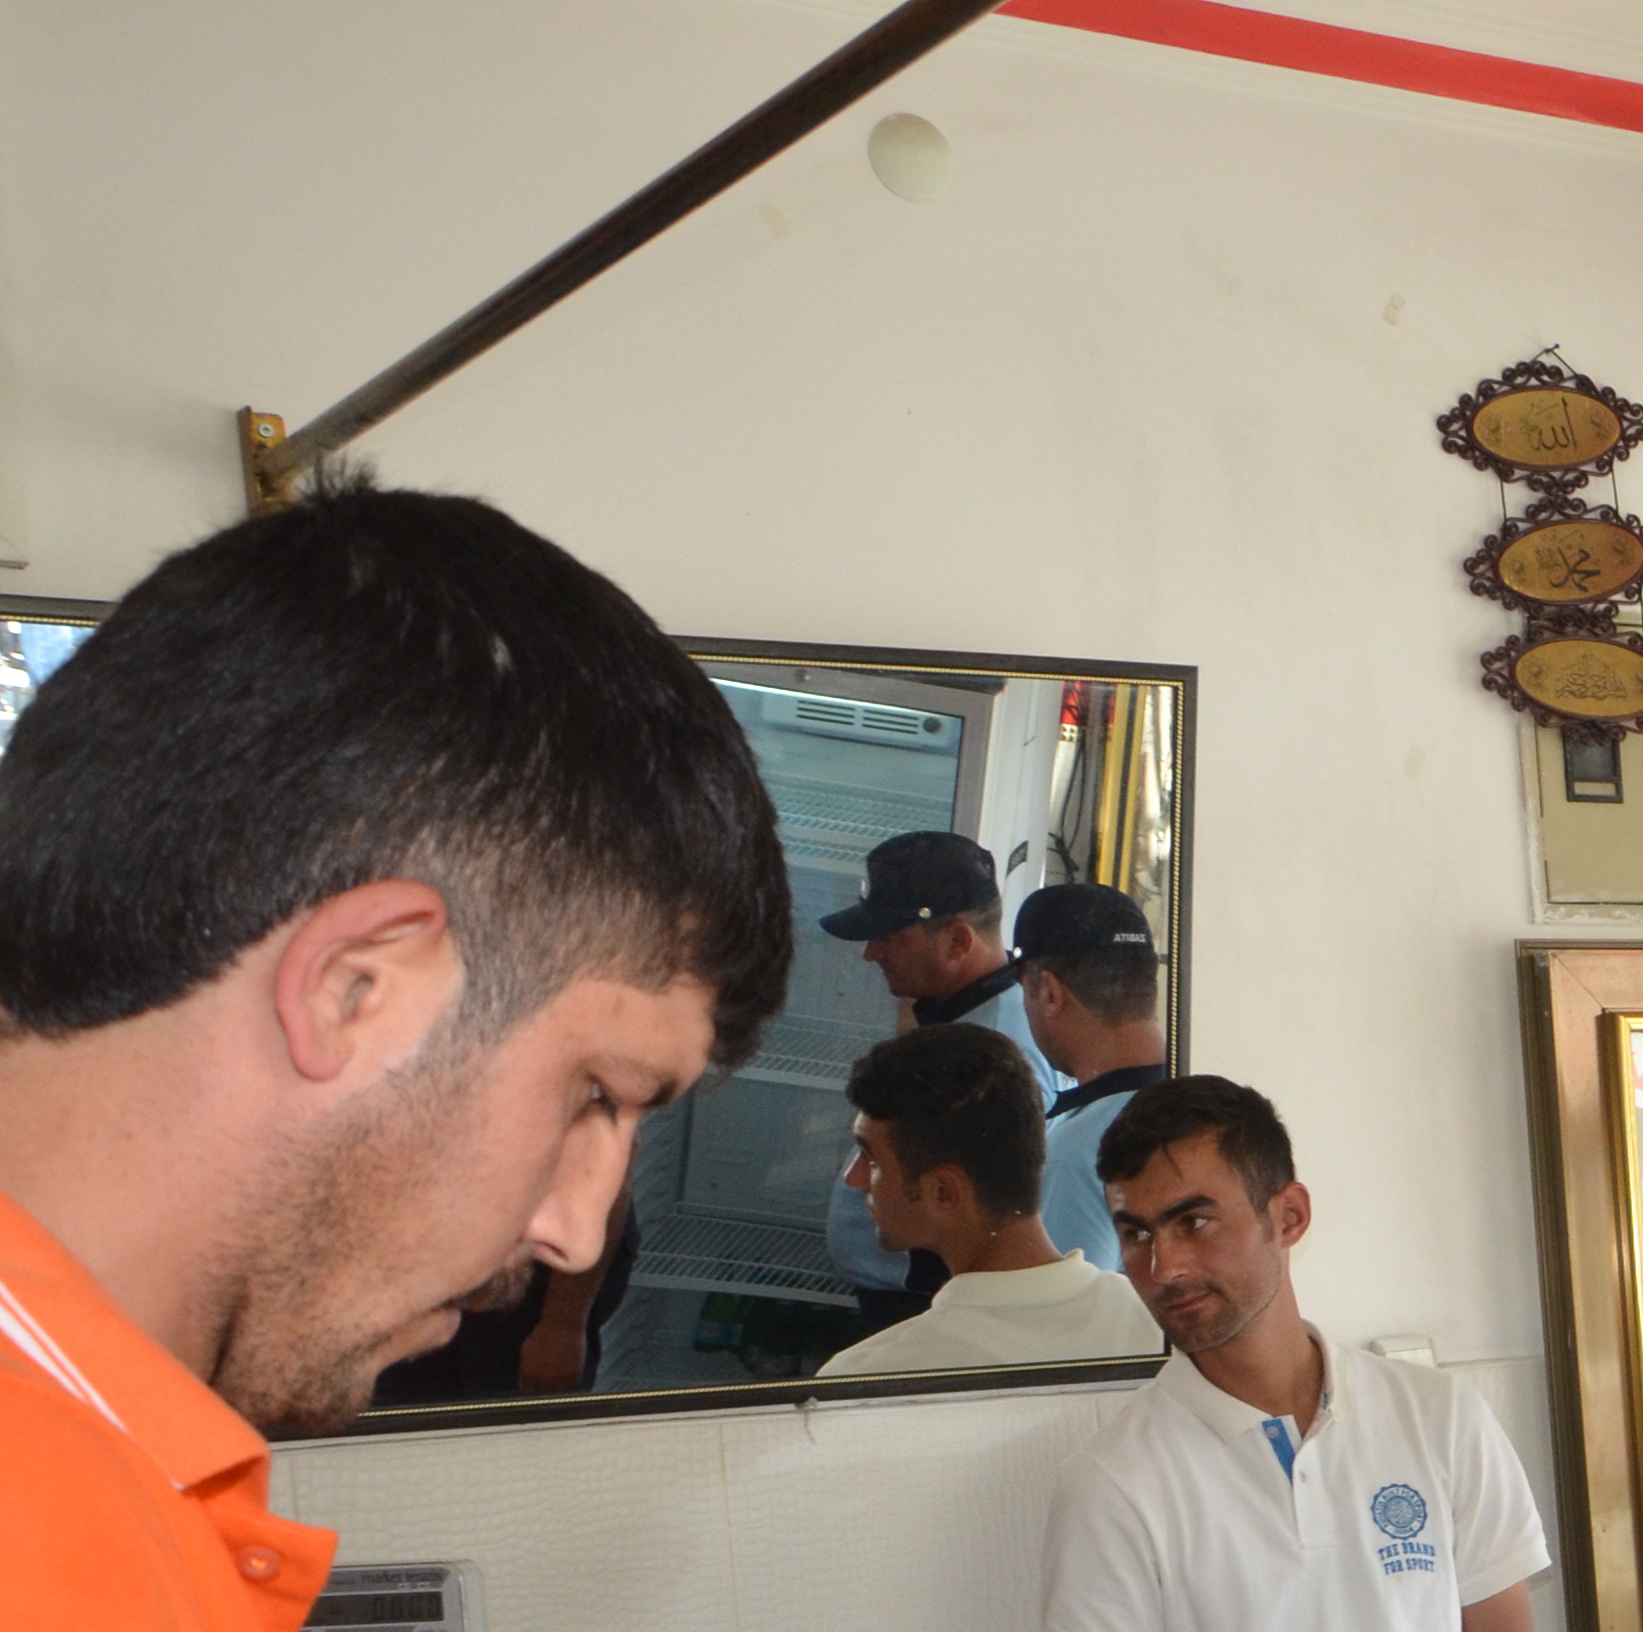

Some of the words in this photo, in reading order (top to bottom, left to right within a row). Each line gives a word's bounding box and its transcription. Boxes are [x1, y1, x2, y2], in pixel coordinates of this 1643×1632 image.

[1378, 1544, 1399, 1560] THE
[1384, 1560, 1404, 1575] FOR
[1405, 1558, 1434, 1572] SPORT
